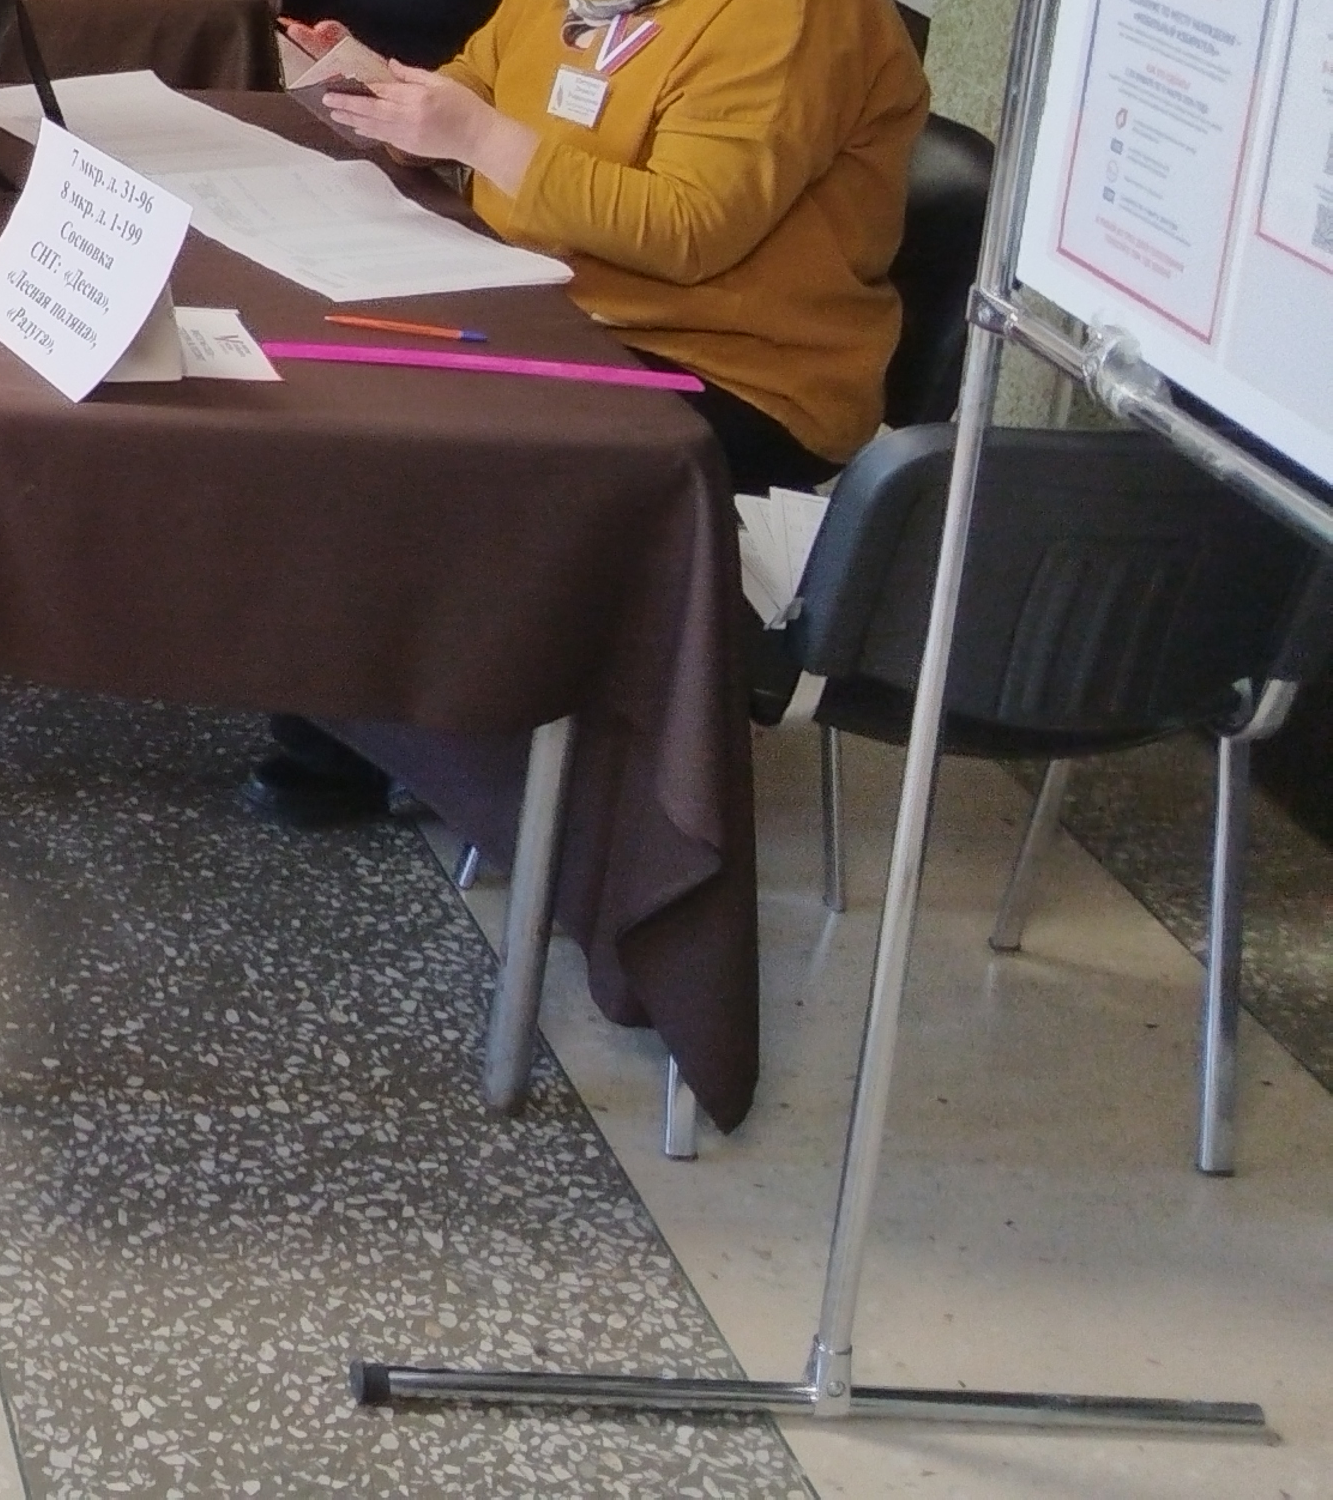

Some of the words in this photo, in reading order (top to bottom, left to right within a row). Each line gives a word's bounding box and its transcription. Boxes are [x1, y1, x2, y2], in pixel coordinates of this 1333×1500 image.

[60, 180, 70, 200] 8
[69, 191, 94, 220] мкр.
[94, 209, 106, 226] д.
[109, 212, 143, 247] 1-199
[71, 148, 79, 168] 7
[81, 159, 105, 188] мкр.
[106, 176, 118, 195] д.
[120, 179, 155, 215] 31-96
[29, 240, 61, 275] СНТ:
[63, 267, 110, 316] «Десна»,
[60, 220, 115, 271] Сосновка
[6, 268, 50, 311] «Лесная
[49, 301, 98, 350] поляна»,
[6, 306, 55, 355] «Радуга»,
